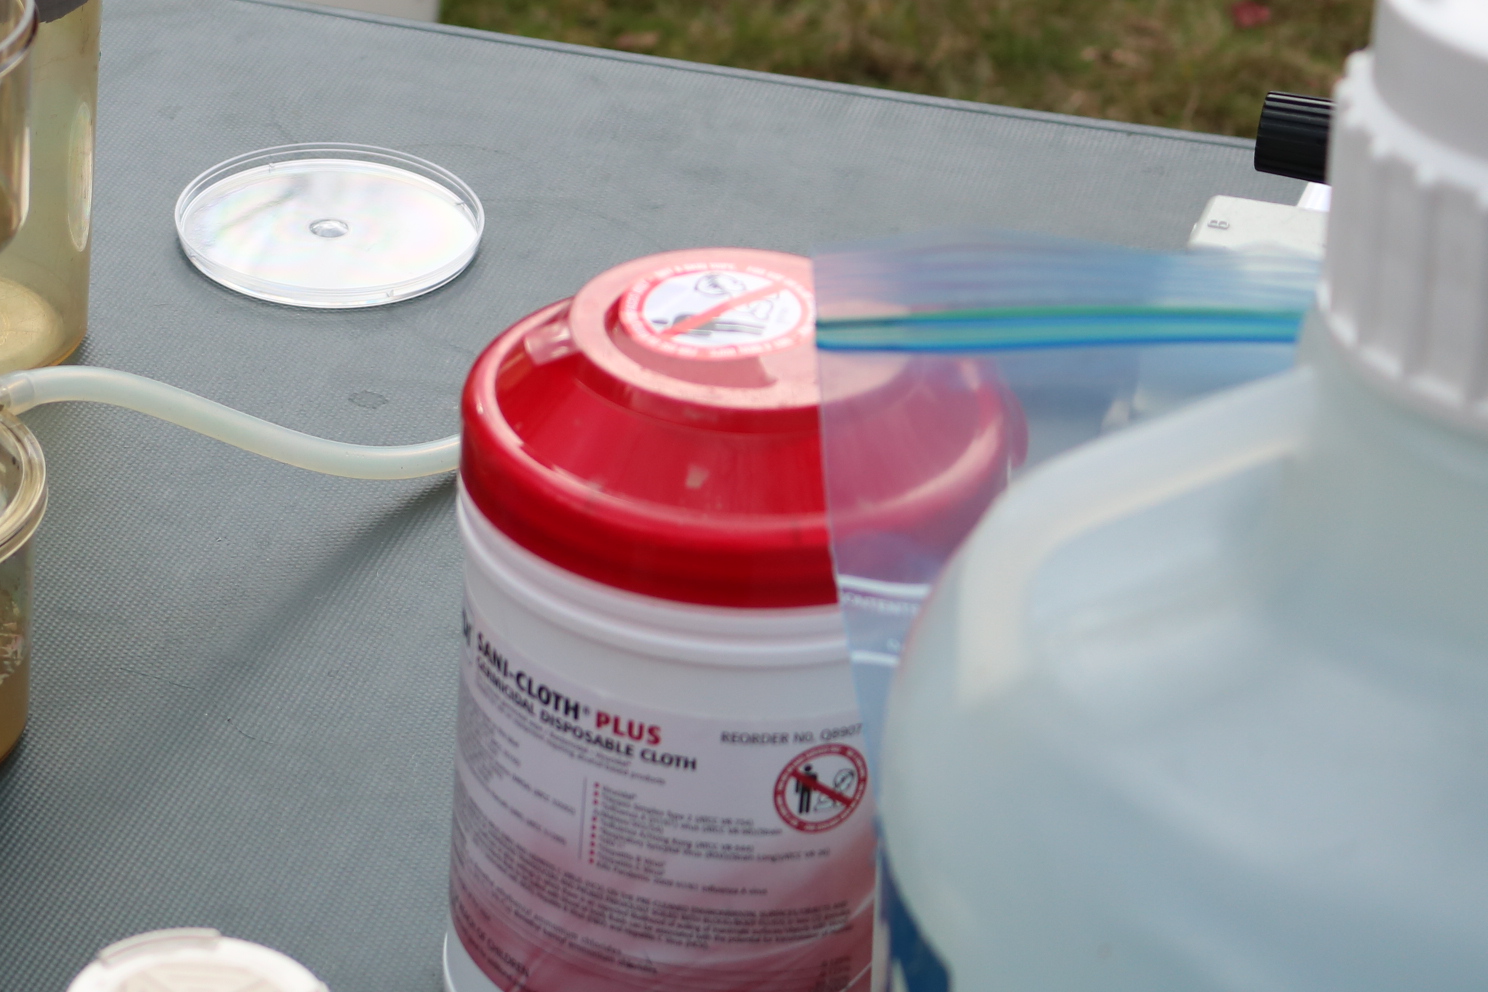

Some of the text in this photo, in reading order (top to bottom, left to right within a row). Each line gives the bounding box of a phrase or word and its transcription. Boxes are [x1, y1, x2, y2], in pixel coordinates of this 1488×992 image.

[539, 708, 635, 758] DISPOSABLE
[639, 746, 698, 771] CLOTH
[595, 710, 661, 745] PLUS
[720, 730, 790, 745] REORDER
